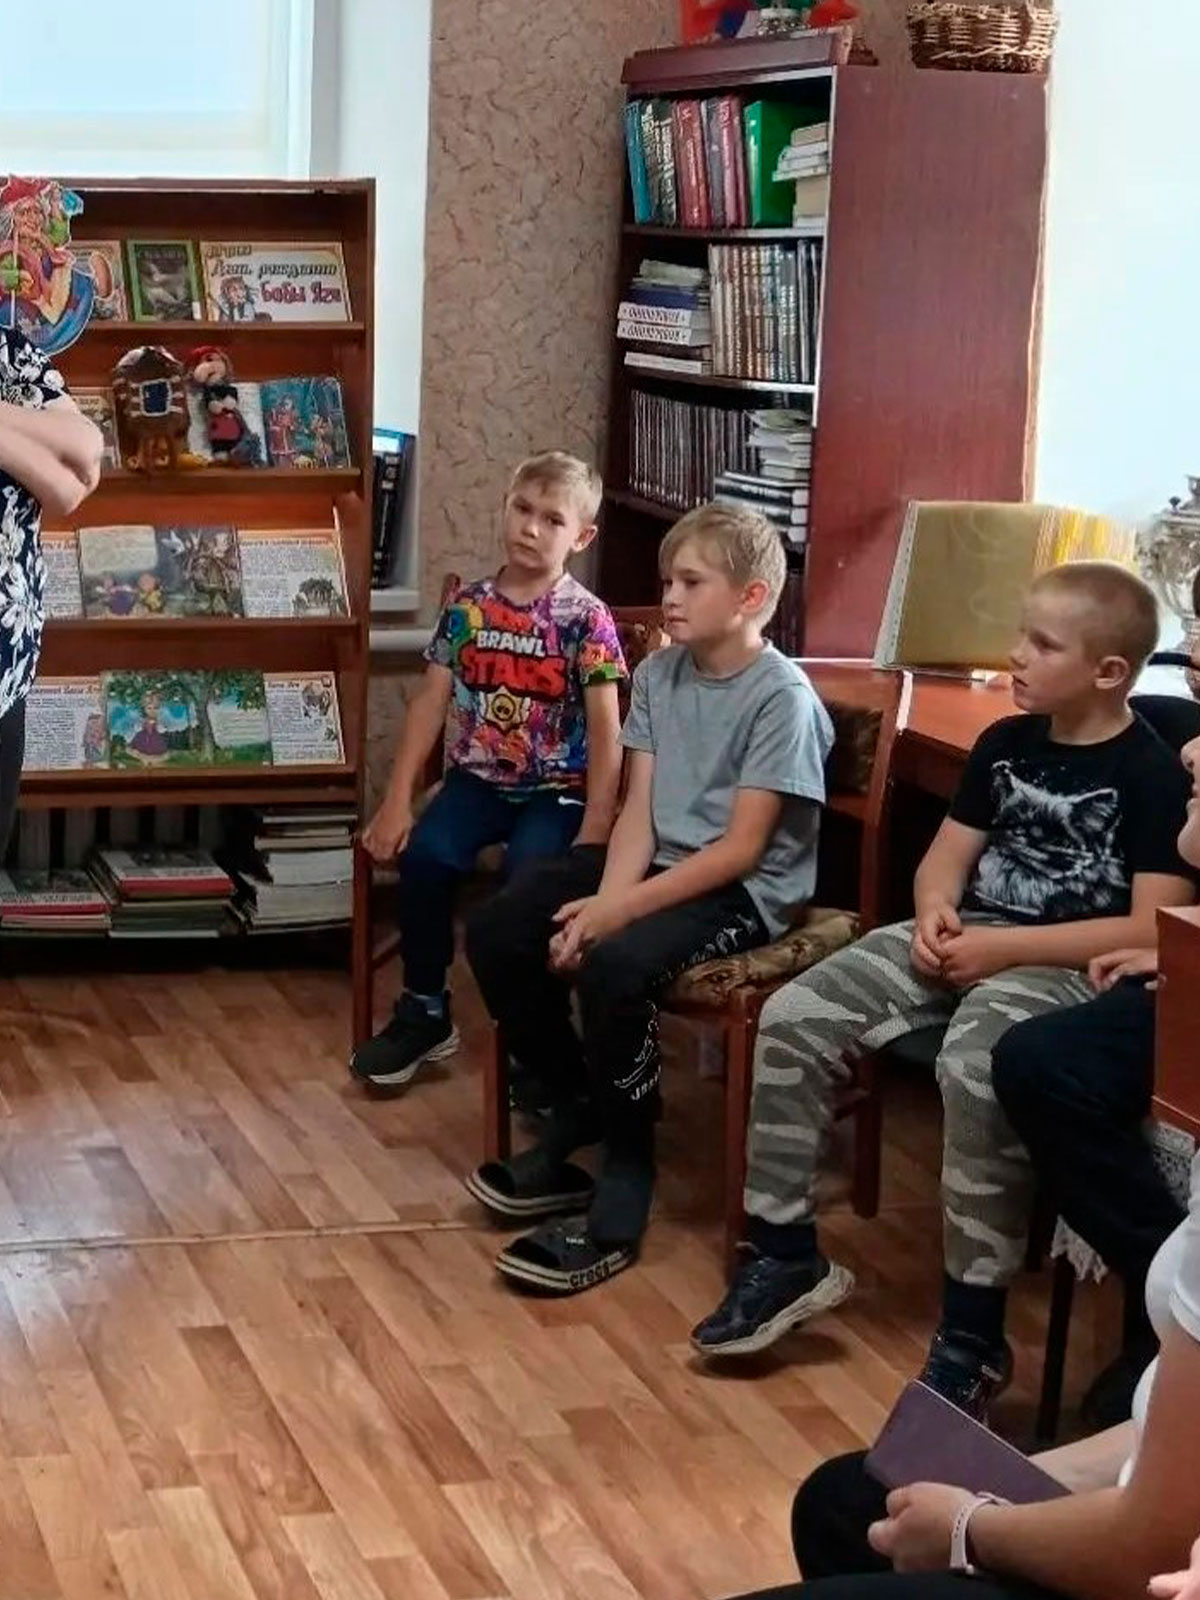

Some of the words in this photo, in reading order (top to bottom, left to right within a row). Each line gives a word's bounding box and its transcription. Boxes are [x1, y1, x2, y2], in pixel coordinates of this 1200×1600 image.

[260, 280, 306, 304] Бабы
[476, 629, 546, 658] BRAWL
[459, 644, 567, 697] STARS
